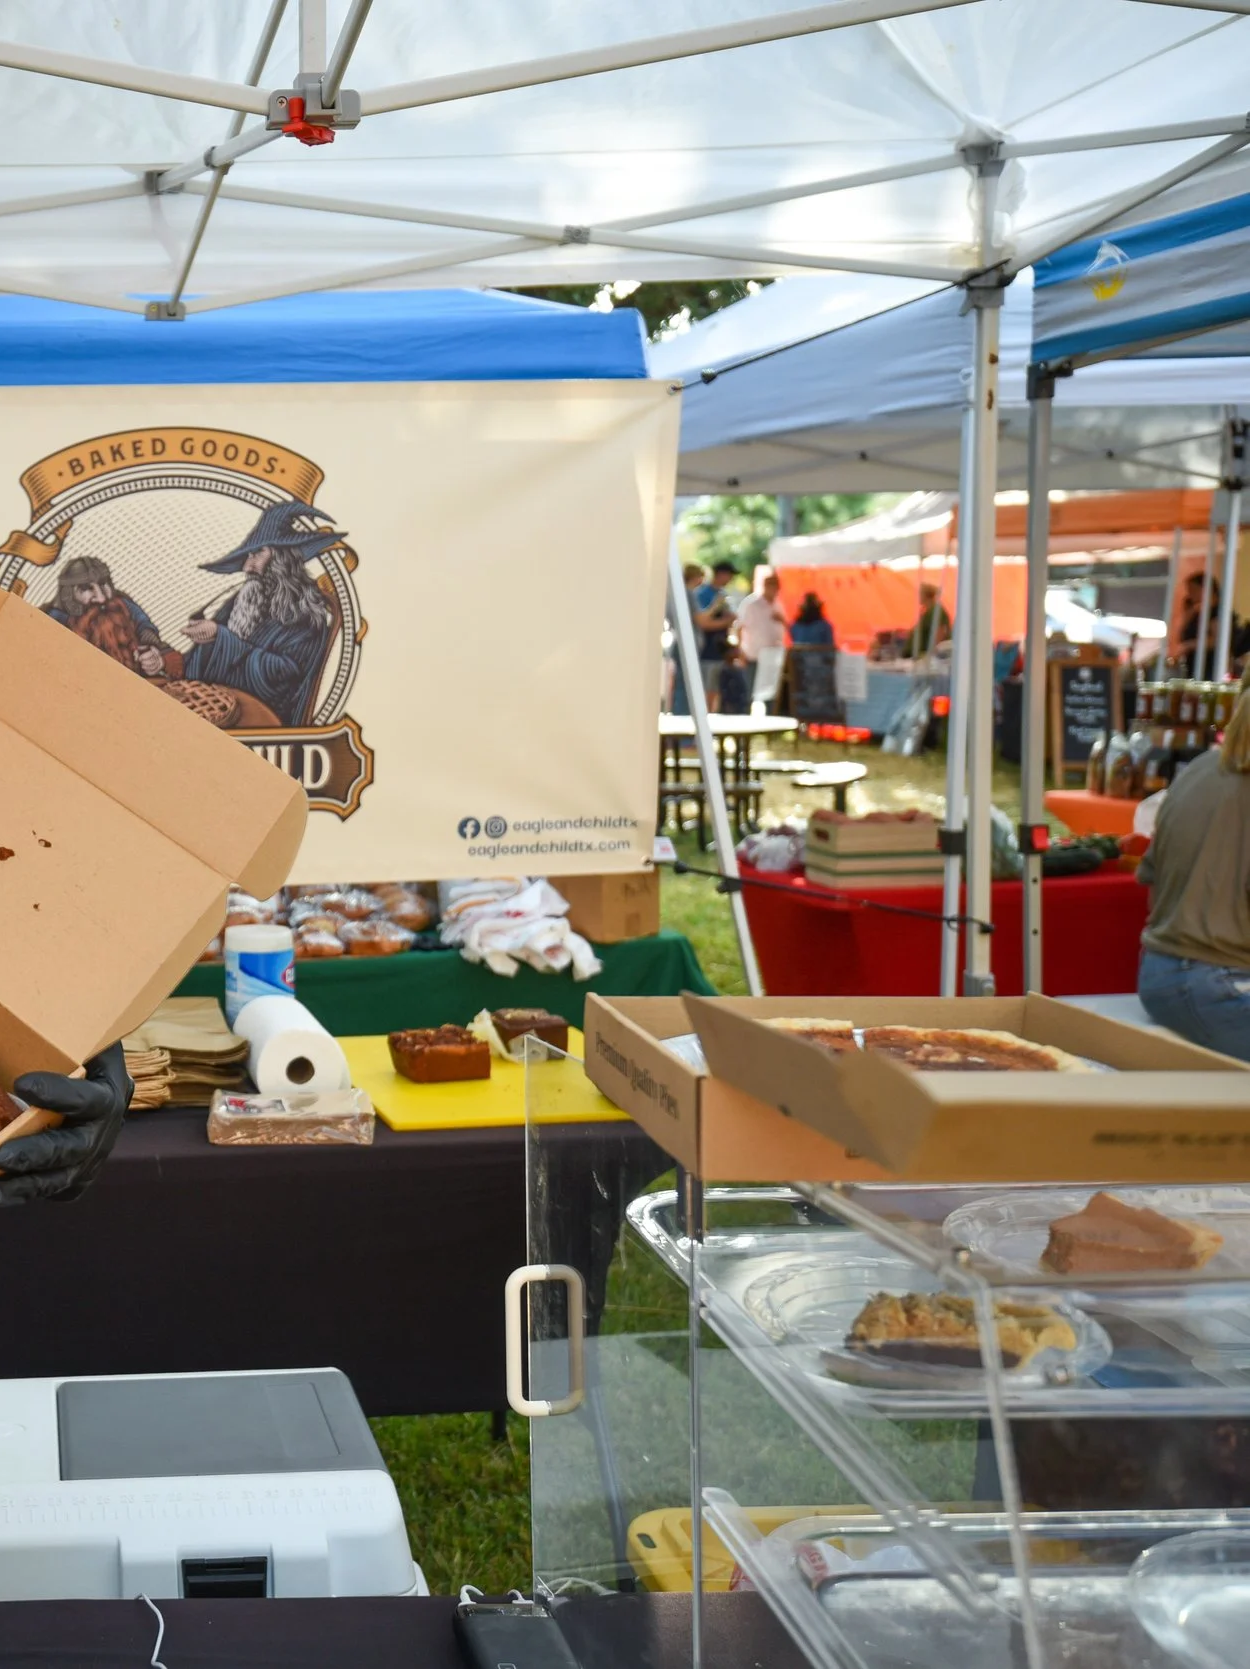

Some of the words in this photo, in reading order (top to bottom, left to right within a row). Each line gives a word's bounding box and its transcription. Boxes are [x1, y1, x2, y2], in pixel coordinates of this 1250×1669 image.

[67, 437, 167, 477] BAKED
[180, 437, 279, 474] GOODS
[512, 816, 638, 835] eagleandchildtx
[467, 838, 631, 859] eagleandchildtx.com
[596, 1031, 629, 1077] Premium
